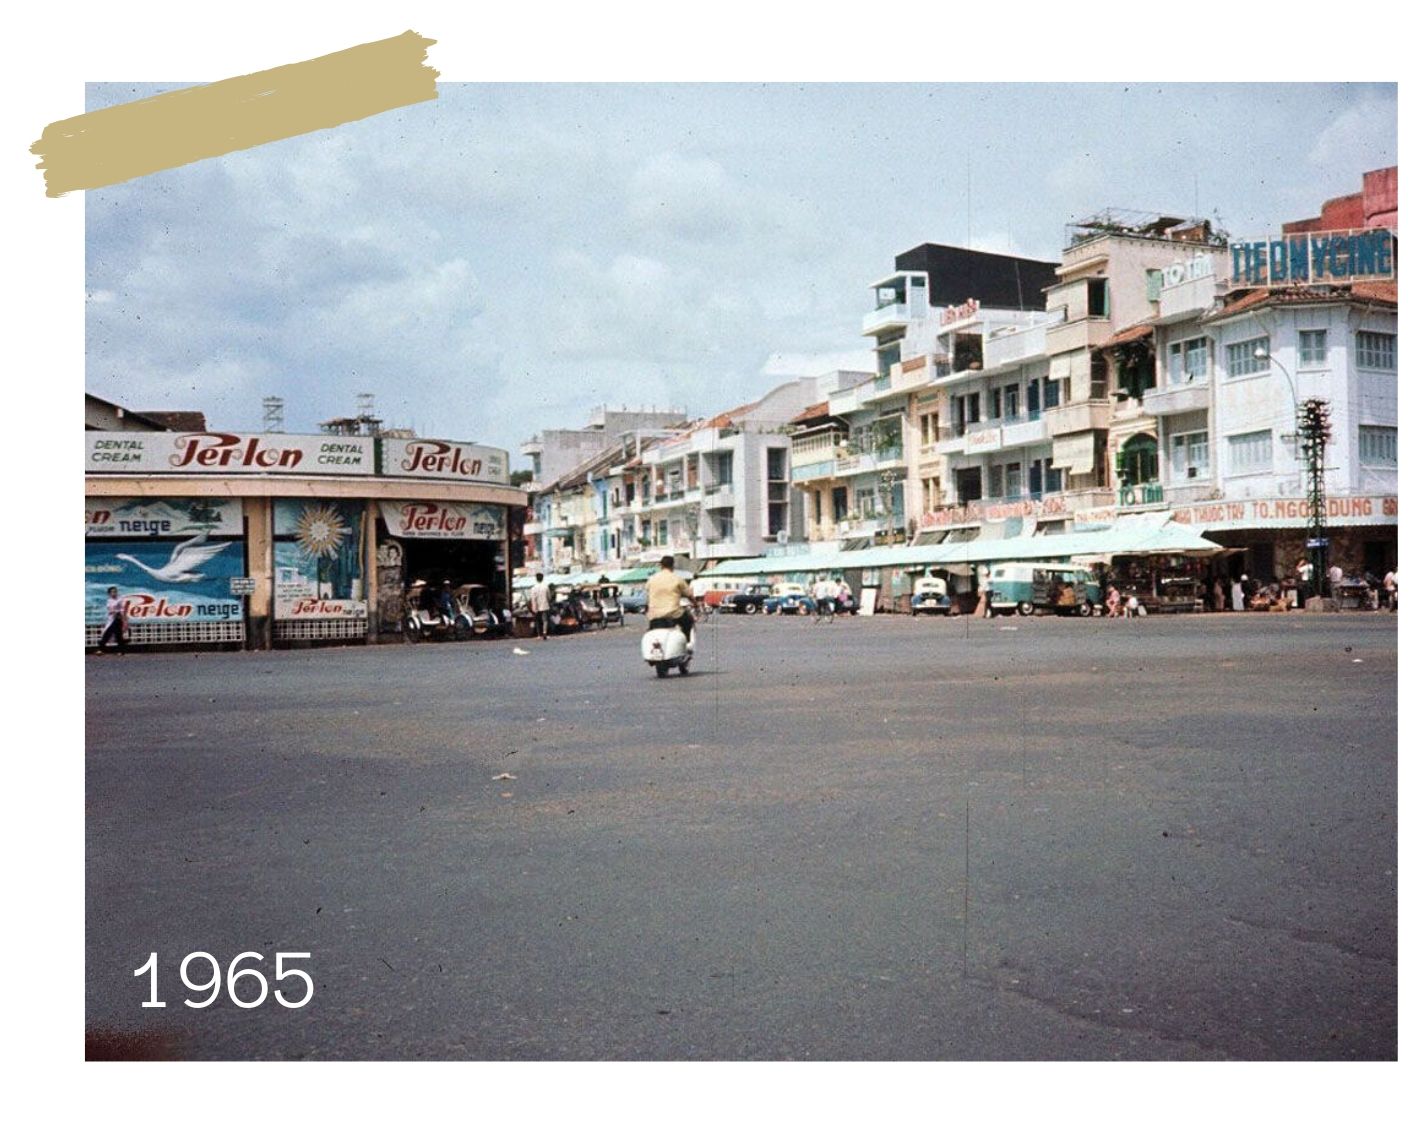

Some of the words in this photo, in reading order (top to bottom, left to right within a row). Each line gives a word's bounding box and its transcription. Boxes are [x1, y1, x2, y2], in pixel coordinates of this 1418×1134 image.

[94, 440, 145, 450] DENTAL
[168, 432, 304, 468] Perlon
[320, 443, 364, 454] DENTAL
[91, 452, 142, 463] CREAM
[318, 455, 362, 465] CREAM
[401, 440, 483, 476] Perlon
[1329, 498, 1372, 518] DUNG
[119, 519, 171, 536] neige
[197, 604, 240, 619] neige
